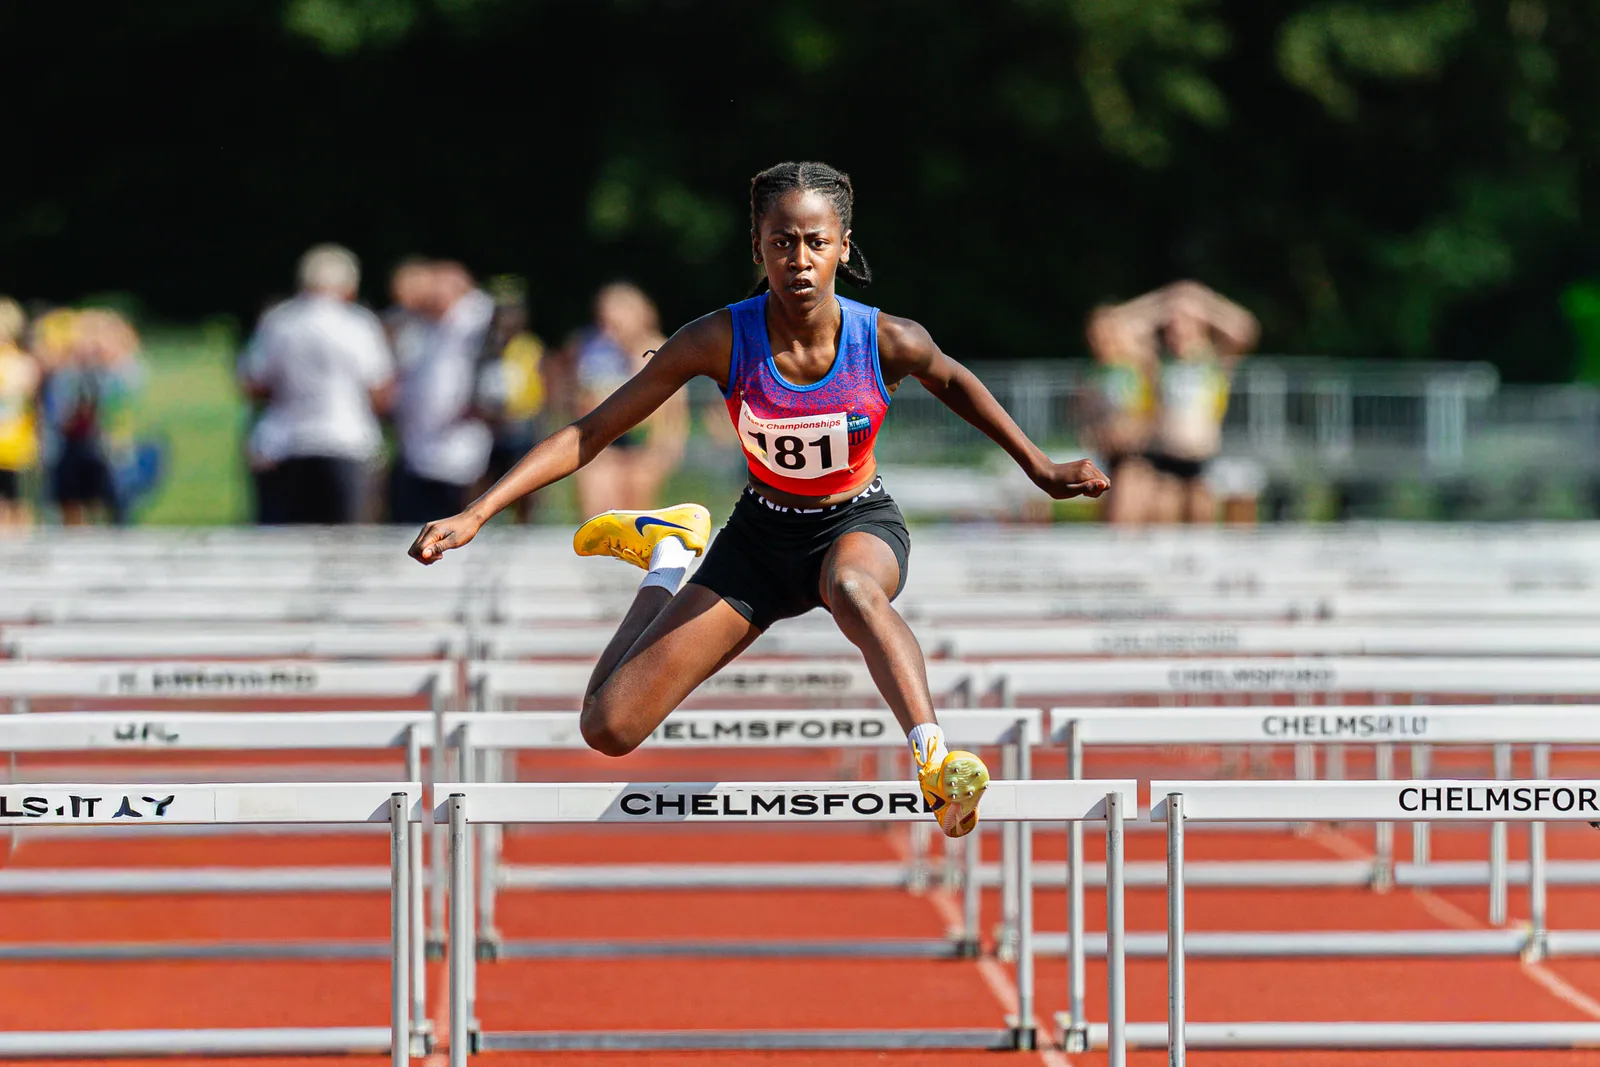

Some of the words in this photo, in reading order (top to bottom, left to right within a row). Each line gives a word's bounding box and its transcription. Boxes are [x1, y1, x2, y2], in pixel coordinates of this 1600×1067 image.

[766, 420, 841, 430] Championships
[748, 430, 833, 470] 181
[651, 720, 885, 739] ELMSFORD
[1398, 787, 1600, 811] CHELMSFOR
